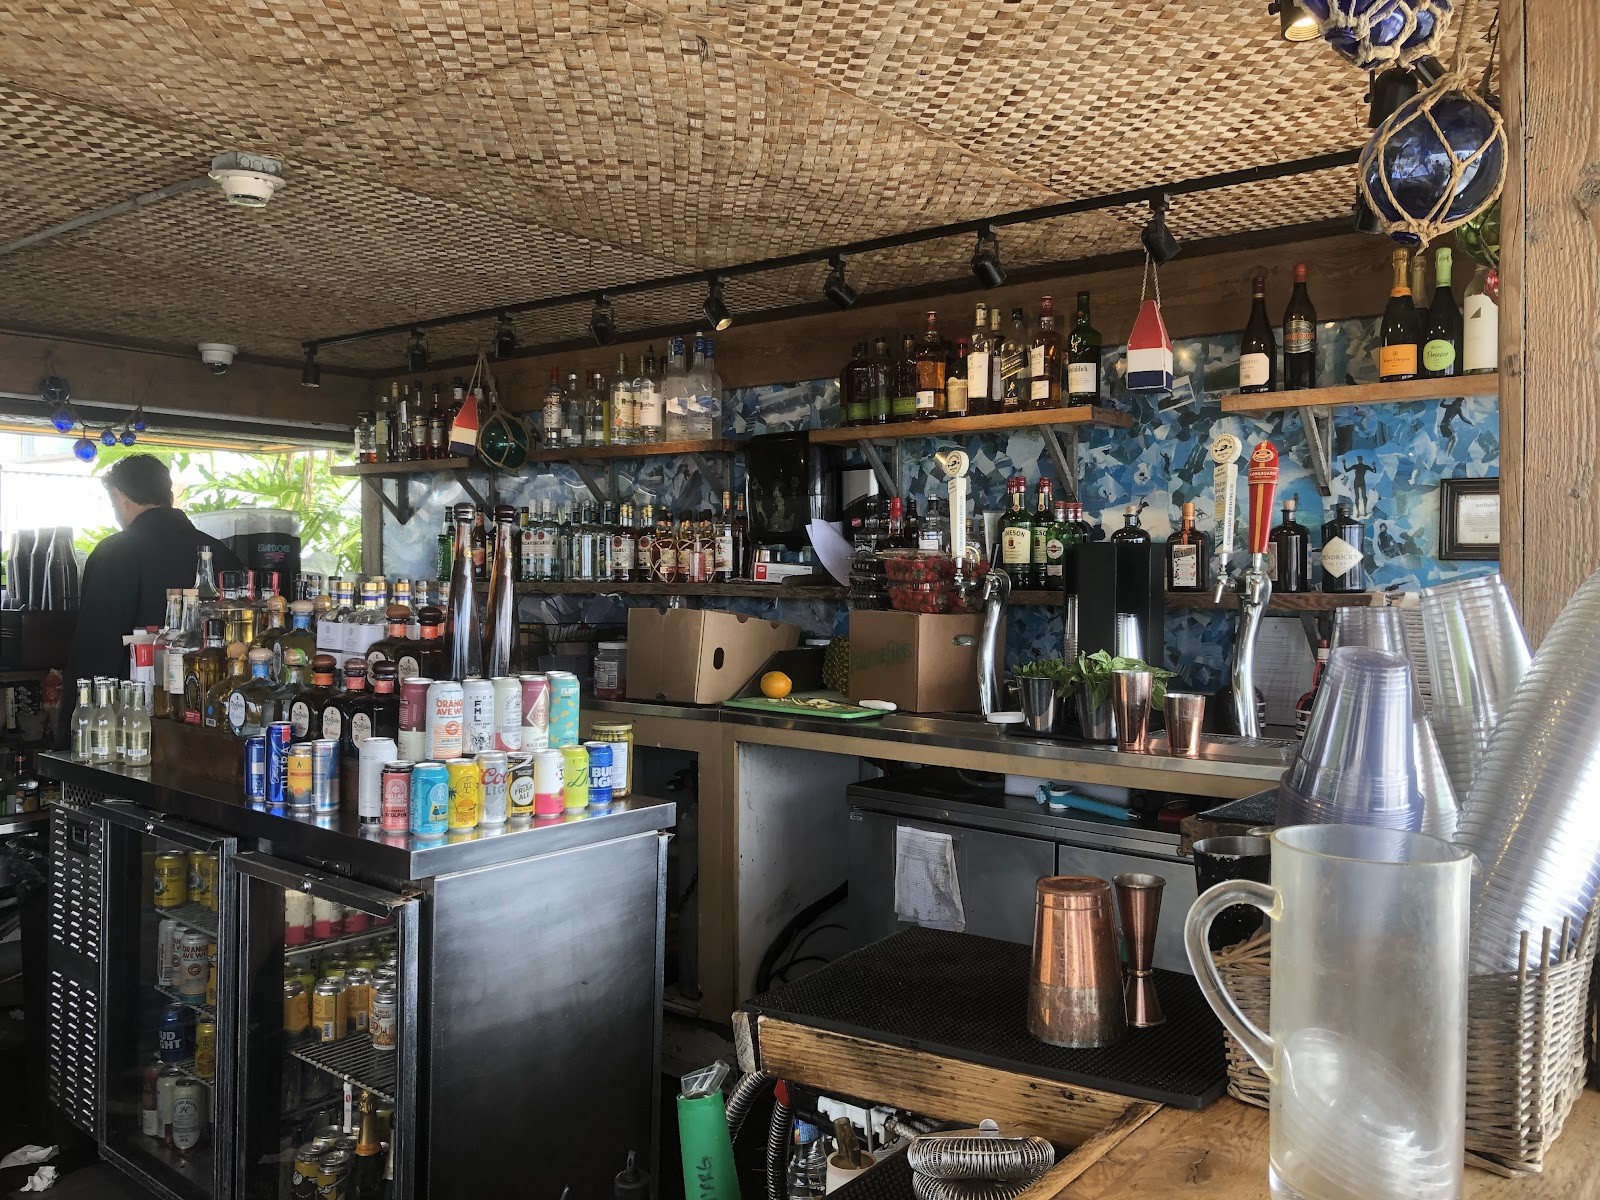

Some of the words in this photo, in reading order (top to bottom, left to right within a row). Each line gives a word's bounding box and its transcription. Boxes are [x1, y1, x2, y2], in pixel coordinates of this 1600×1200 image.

[1427, 351, 1449, 359] Prosecco
[1005, 530, 1025, 538] MESON
[280, 746, 291, 789] ULTRA
[480, 767, 509, 786] Coo
[588, 777, 613, 788] LIGH
[485, 786, 506, 796] LIG
[514, 784, 533, 795] FRIAR
[518, 792, 530, 801] ALE
[160, 1031, 176, 1041] UD
[159, 1039, 182, 1050] GHT
